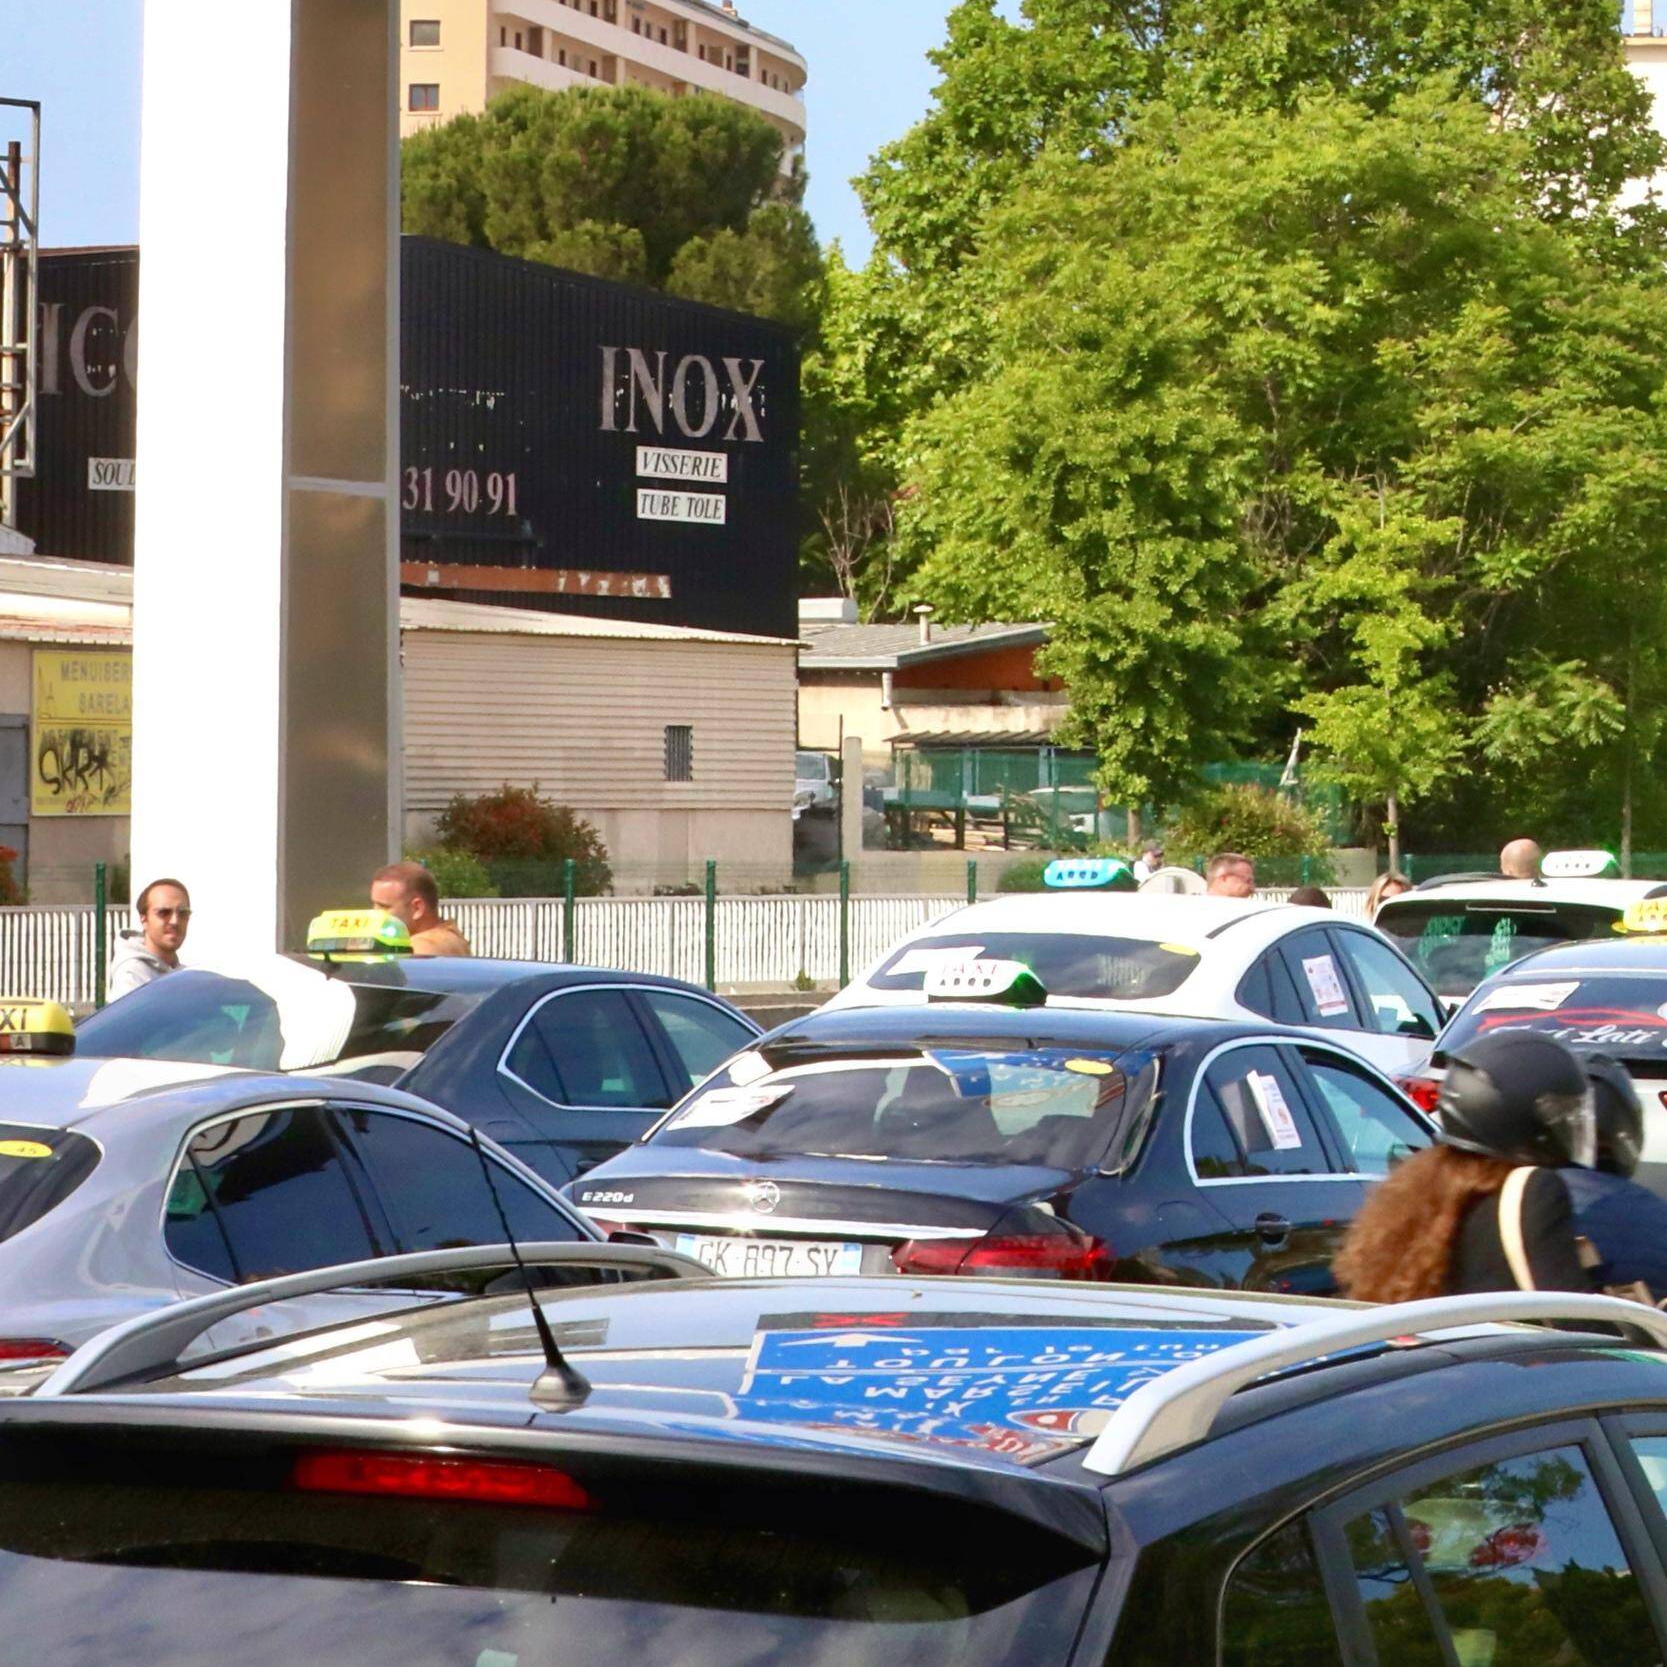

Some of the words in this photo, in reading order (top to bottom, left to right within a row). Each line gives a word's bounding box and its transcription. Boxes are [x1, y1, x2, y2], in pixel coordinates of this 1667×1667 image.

[598, 345, 765, 442] INOX
[642, 451, 722, 480] VISSERIE
[402, 467, 433, 512] 31
[445, 469, 478, 513] 90
[486, 471, 517, 516] 91
[641, 493, 680, 518] TUBE
[687, 496, 722, 520] TOLE
